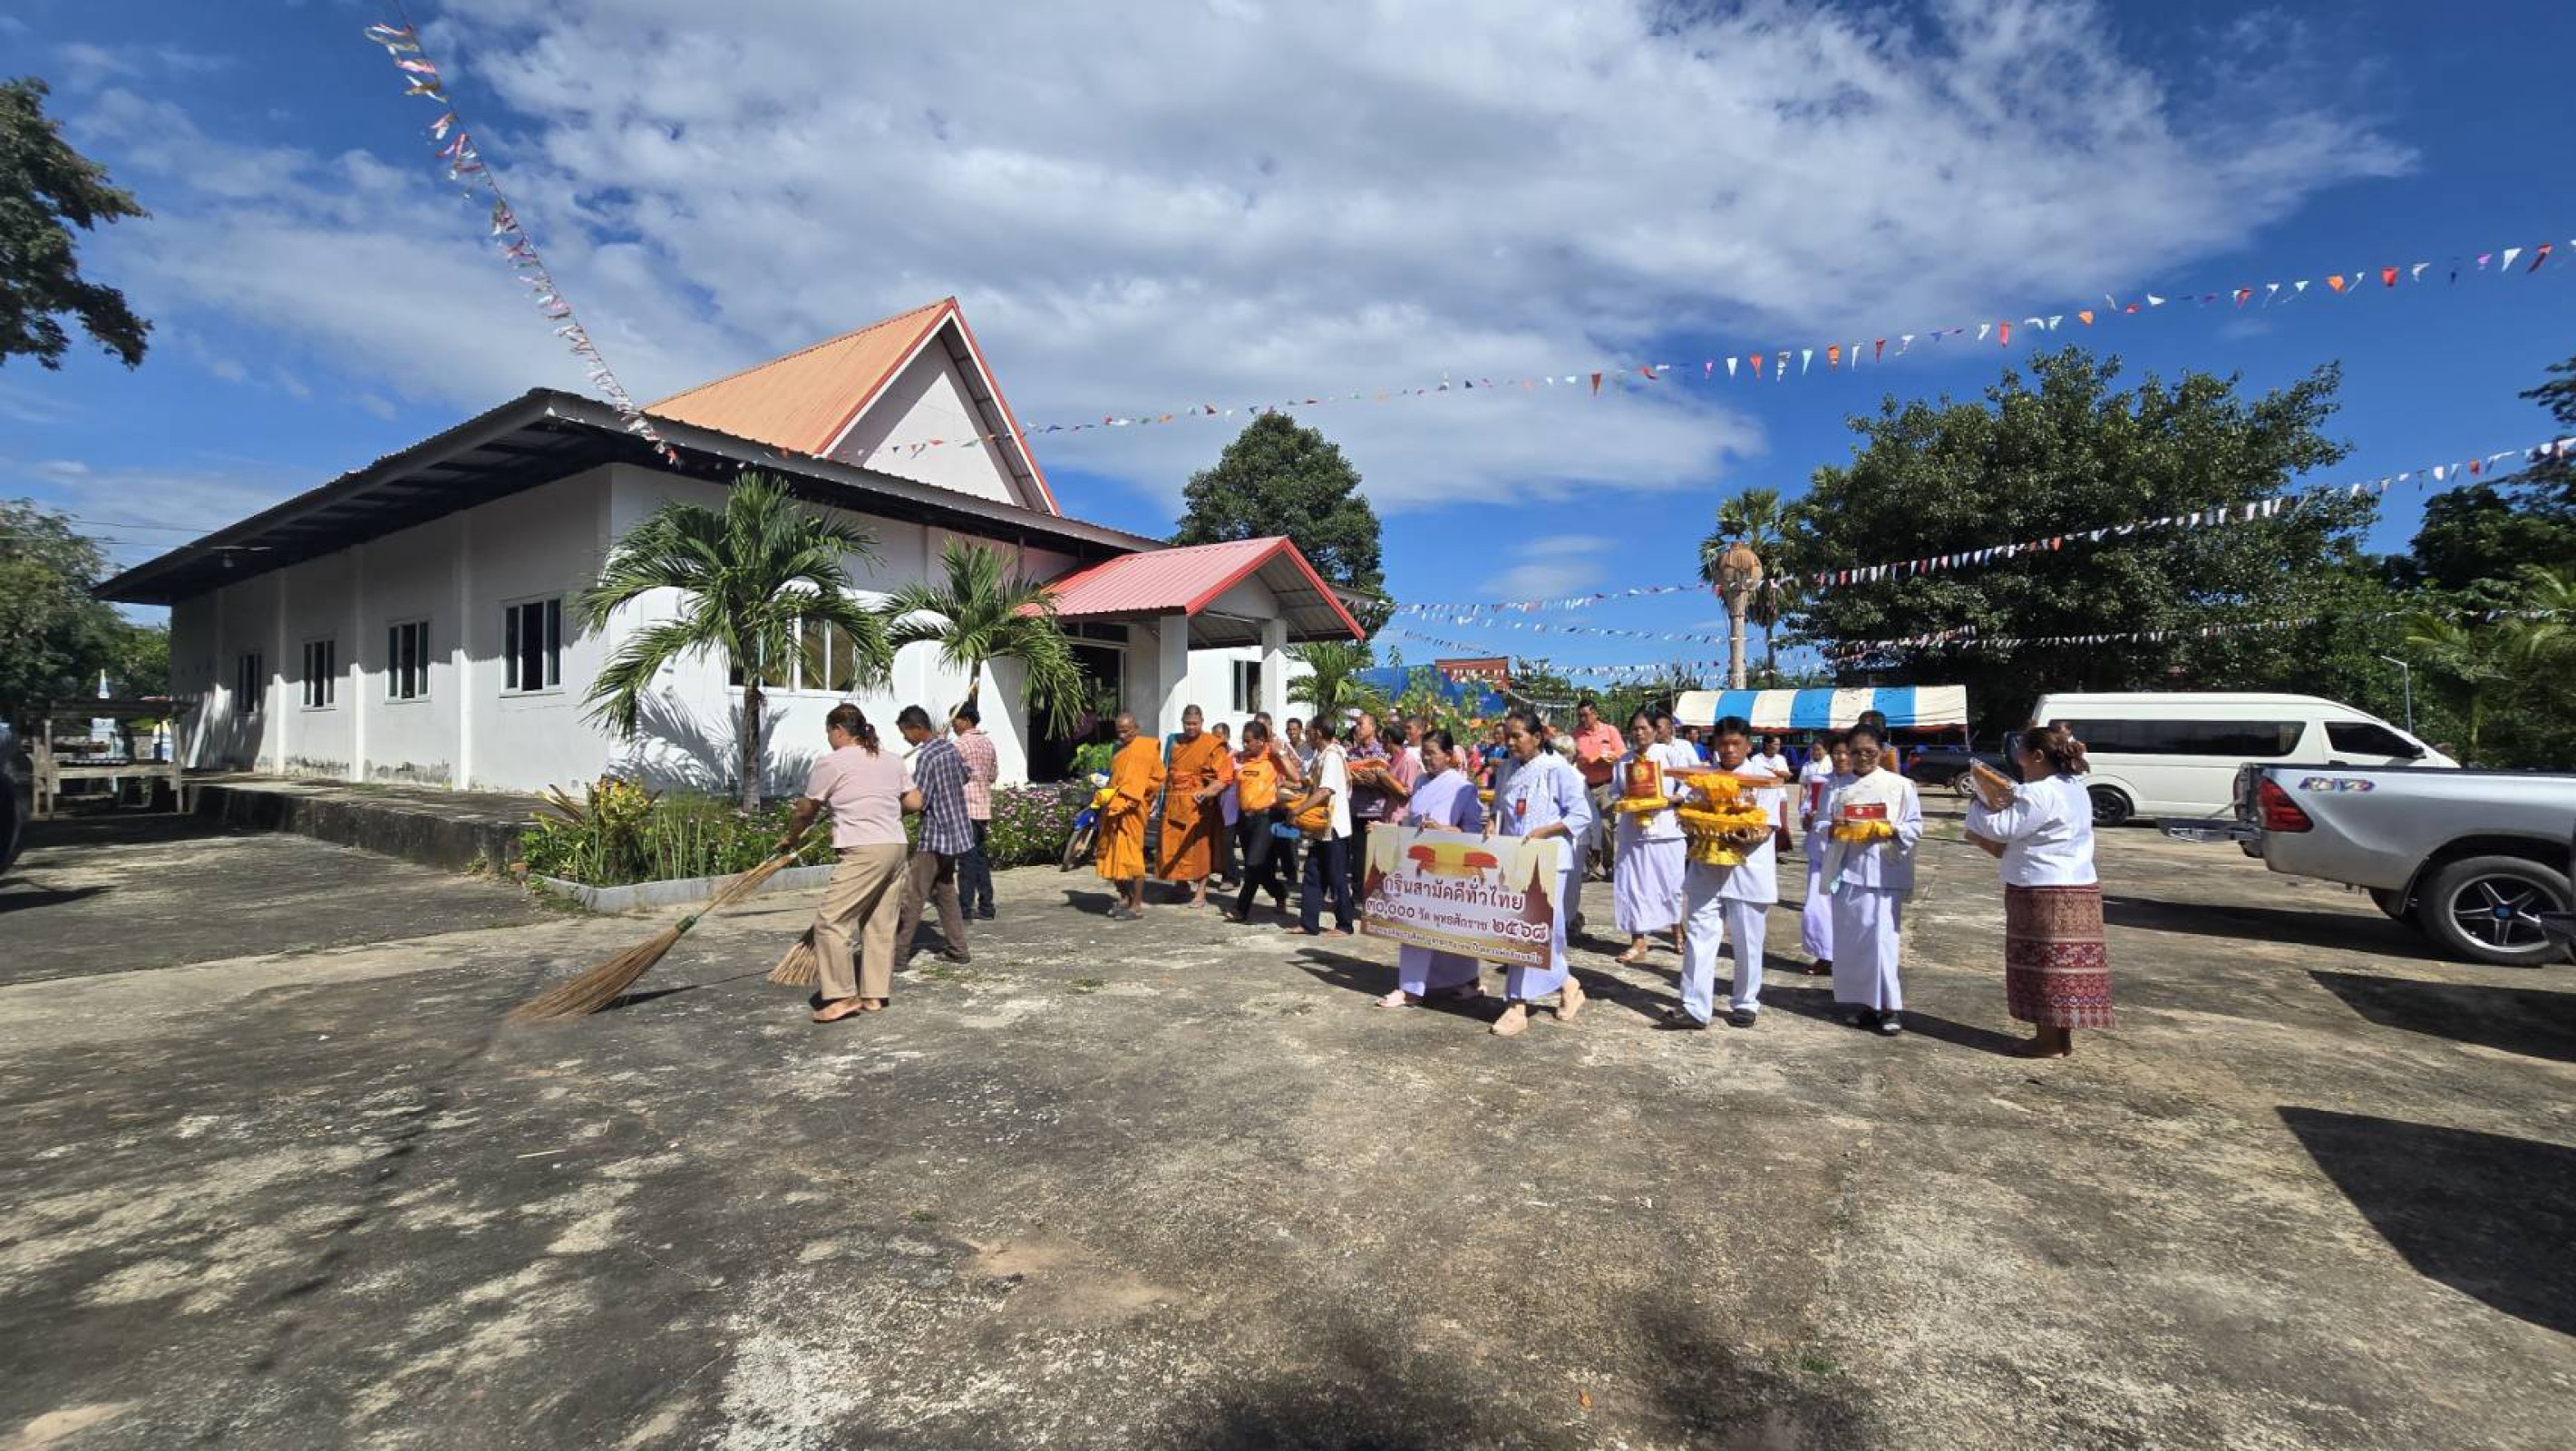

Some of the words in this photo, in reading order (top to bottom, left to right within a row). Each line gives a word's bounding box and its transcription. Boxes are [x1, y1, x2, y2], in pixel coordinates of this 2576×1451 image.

[1385, 873, 1523, 911] กฐินสามัคคีทั่วไทย
[1492, 918, 1547, 940] ๒๕๖๘
